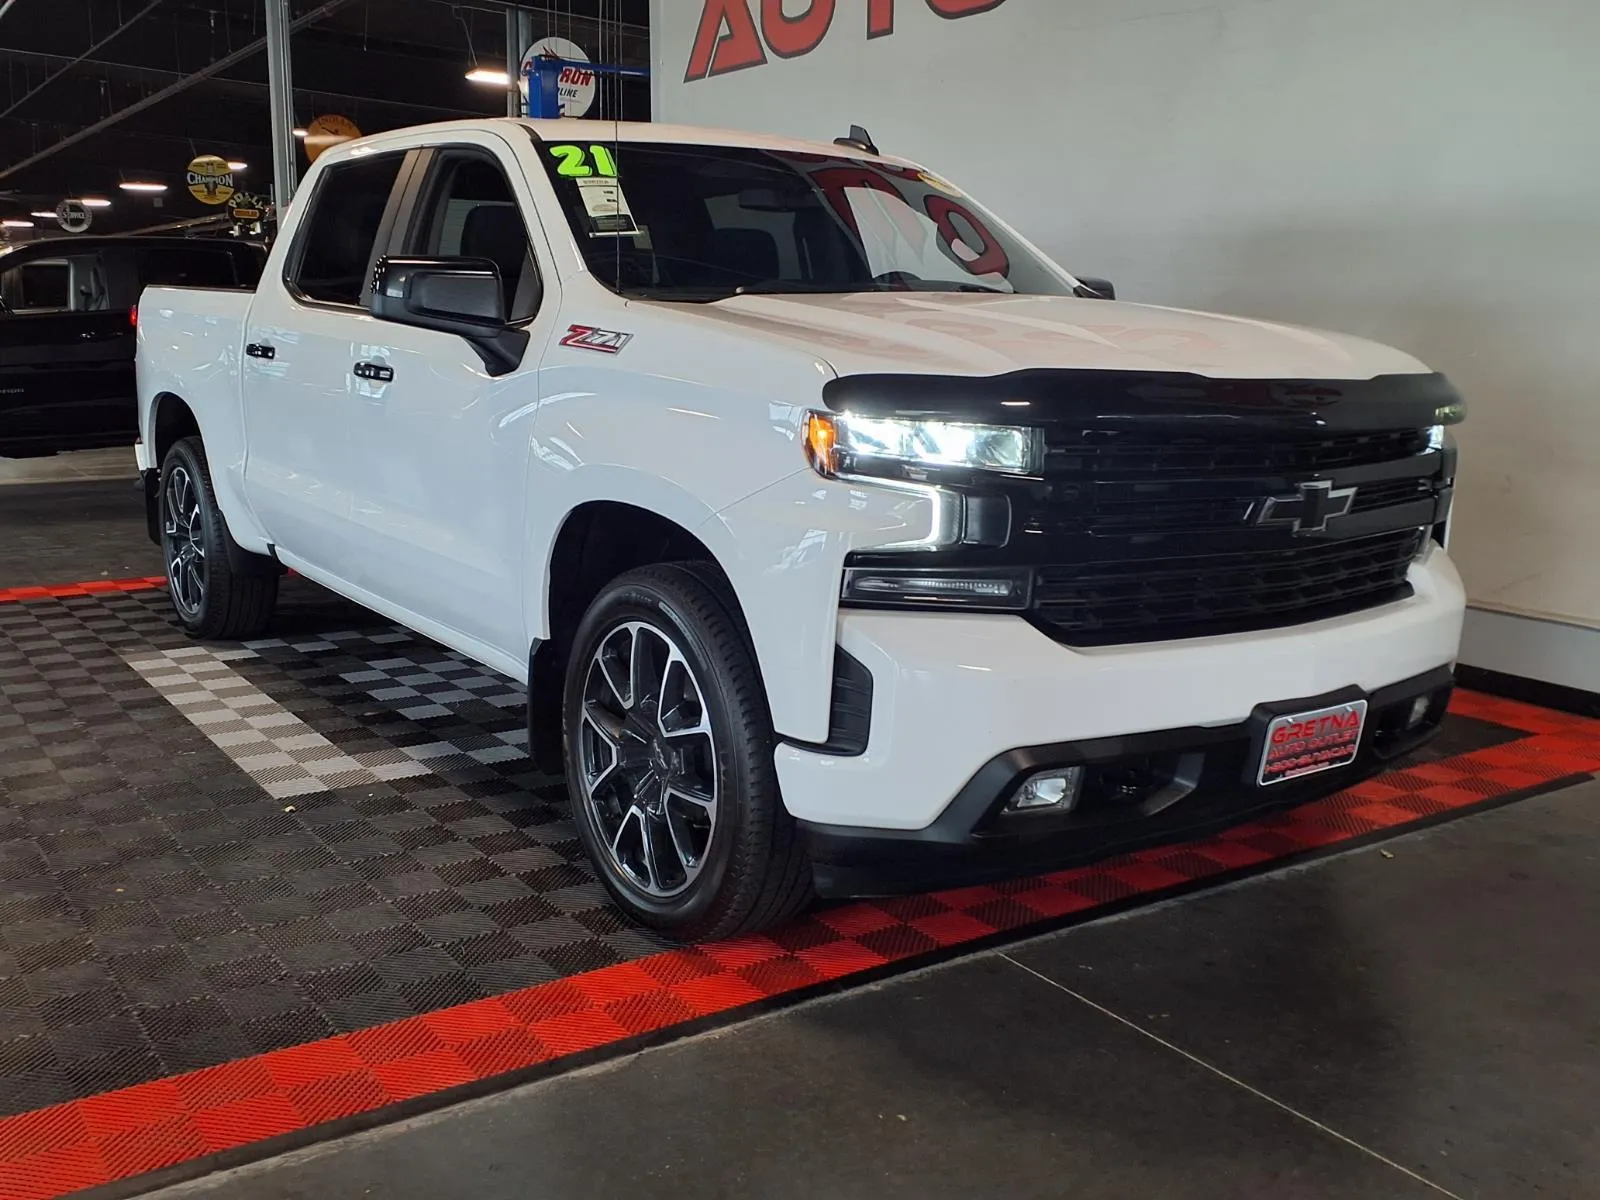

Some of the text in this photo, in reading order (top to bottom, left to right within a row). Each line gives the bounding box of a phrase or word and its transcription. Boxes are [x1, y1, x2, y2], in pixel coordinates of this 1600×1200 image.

[683, 0, 1004, 83] AU
[549, 145, 618, 177] 21
[559, 324, 633, 355] Z71
[1272, 710, 1359, 744] GRETNA
[1268, 728, 1360, 760] AUTO OUTLET
